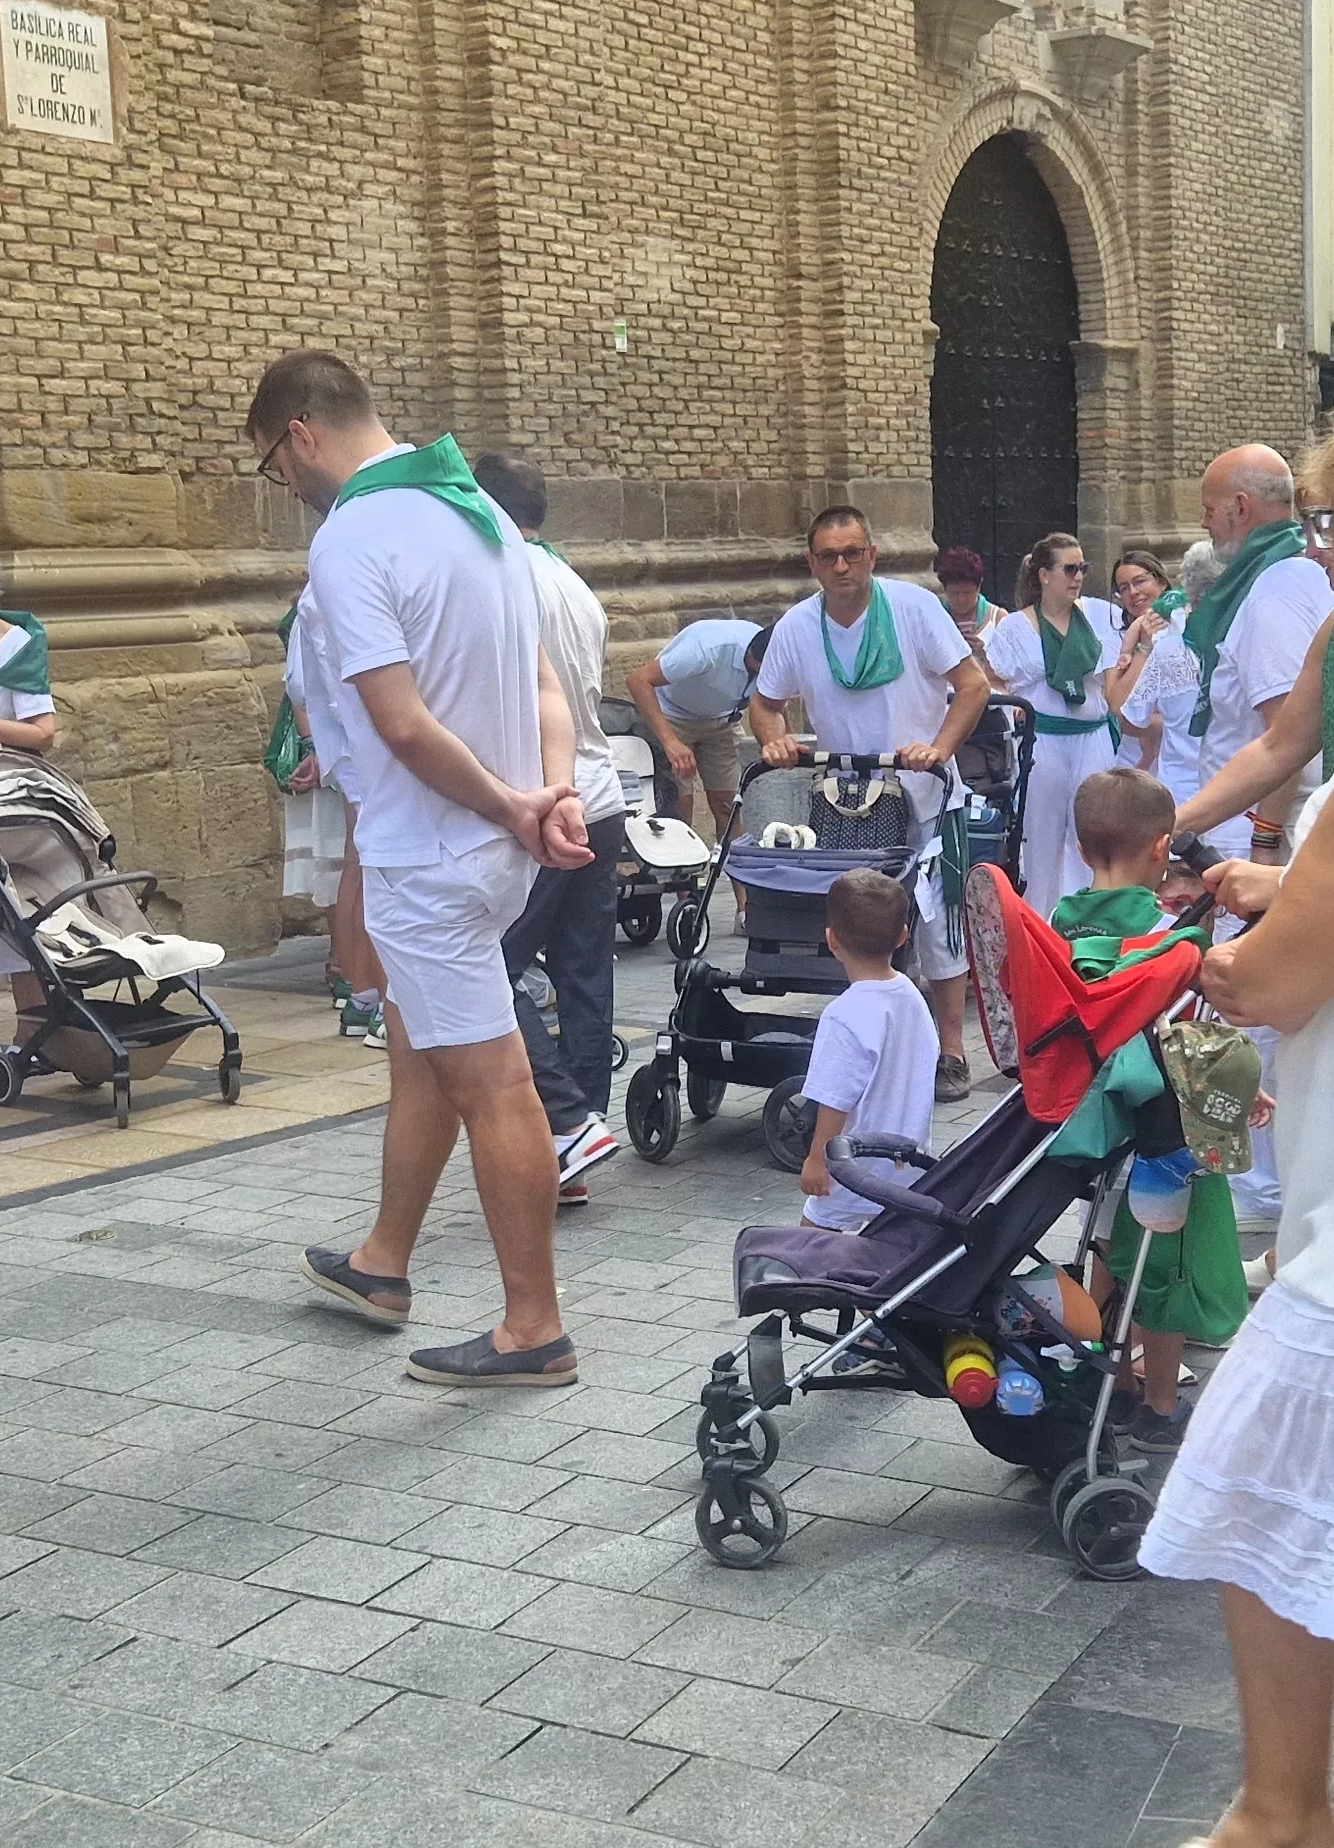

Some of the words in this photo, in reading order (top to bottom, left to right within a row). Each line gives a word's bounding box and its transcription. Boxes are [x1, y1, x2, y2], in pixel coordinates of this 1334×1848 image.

[68, 22, 97, 47] REAL
[13, 38, 20, 59] Y
[25, 41, 99, 74] PARROQUIAL
[50, 73, 67, 95] DE
[30, 96, 85, 125] LORENZO
